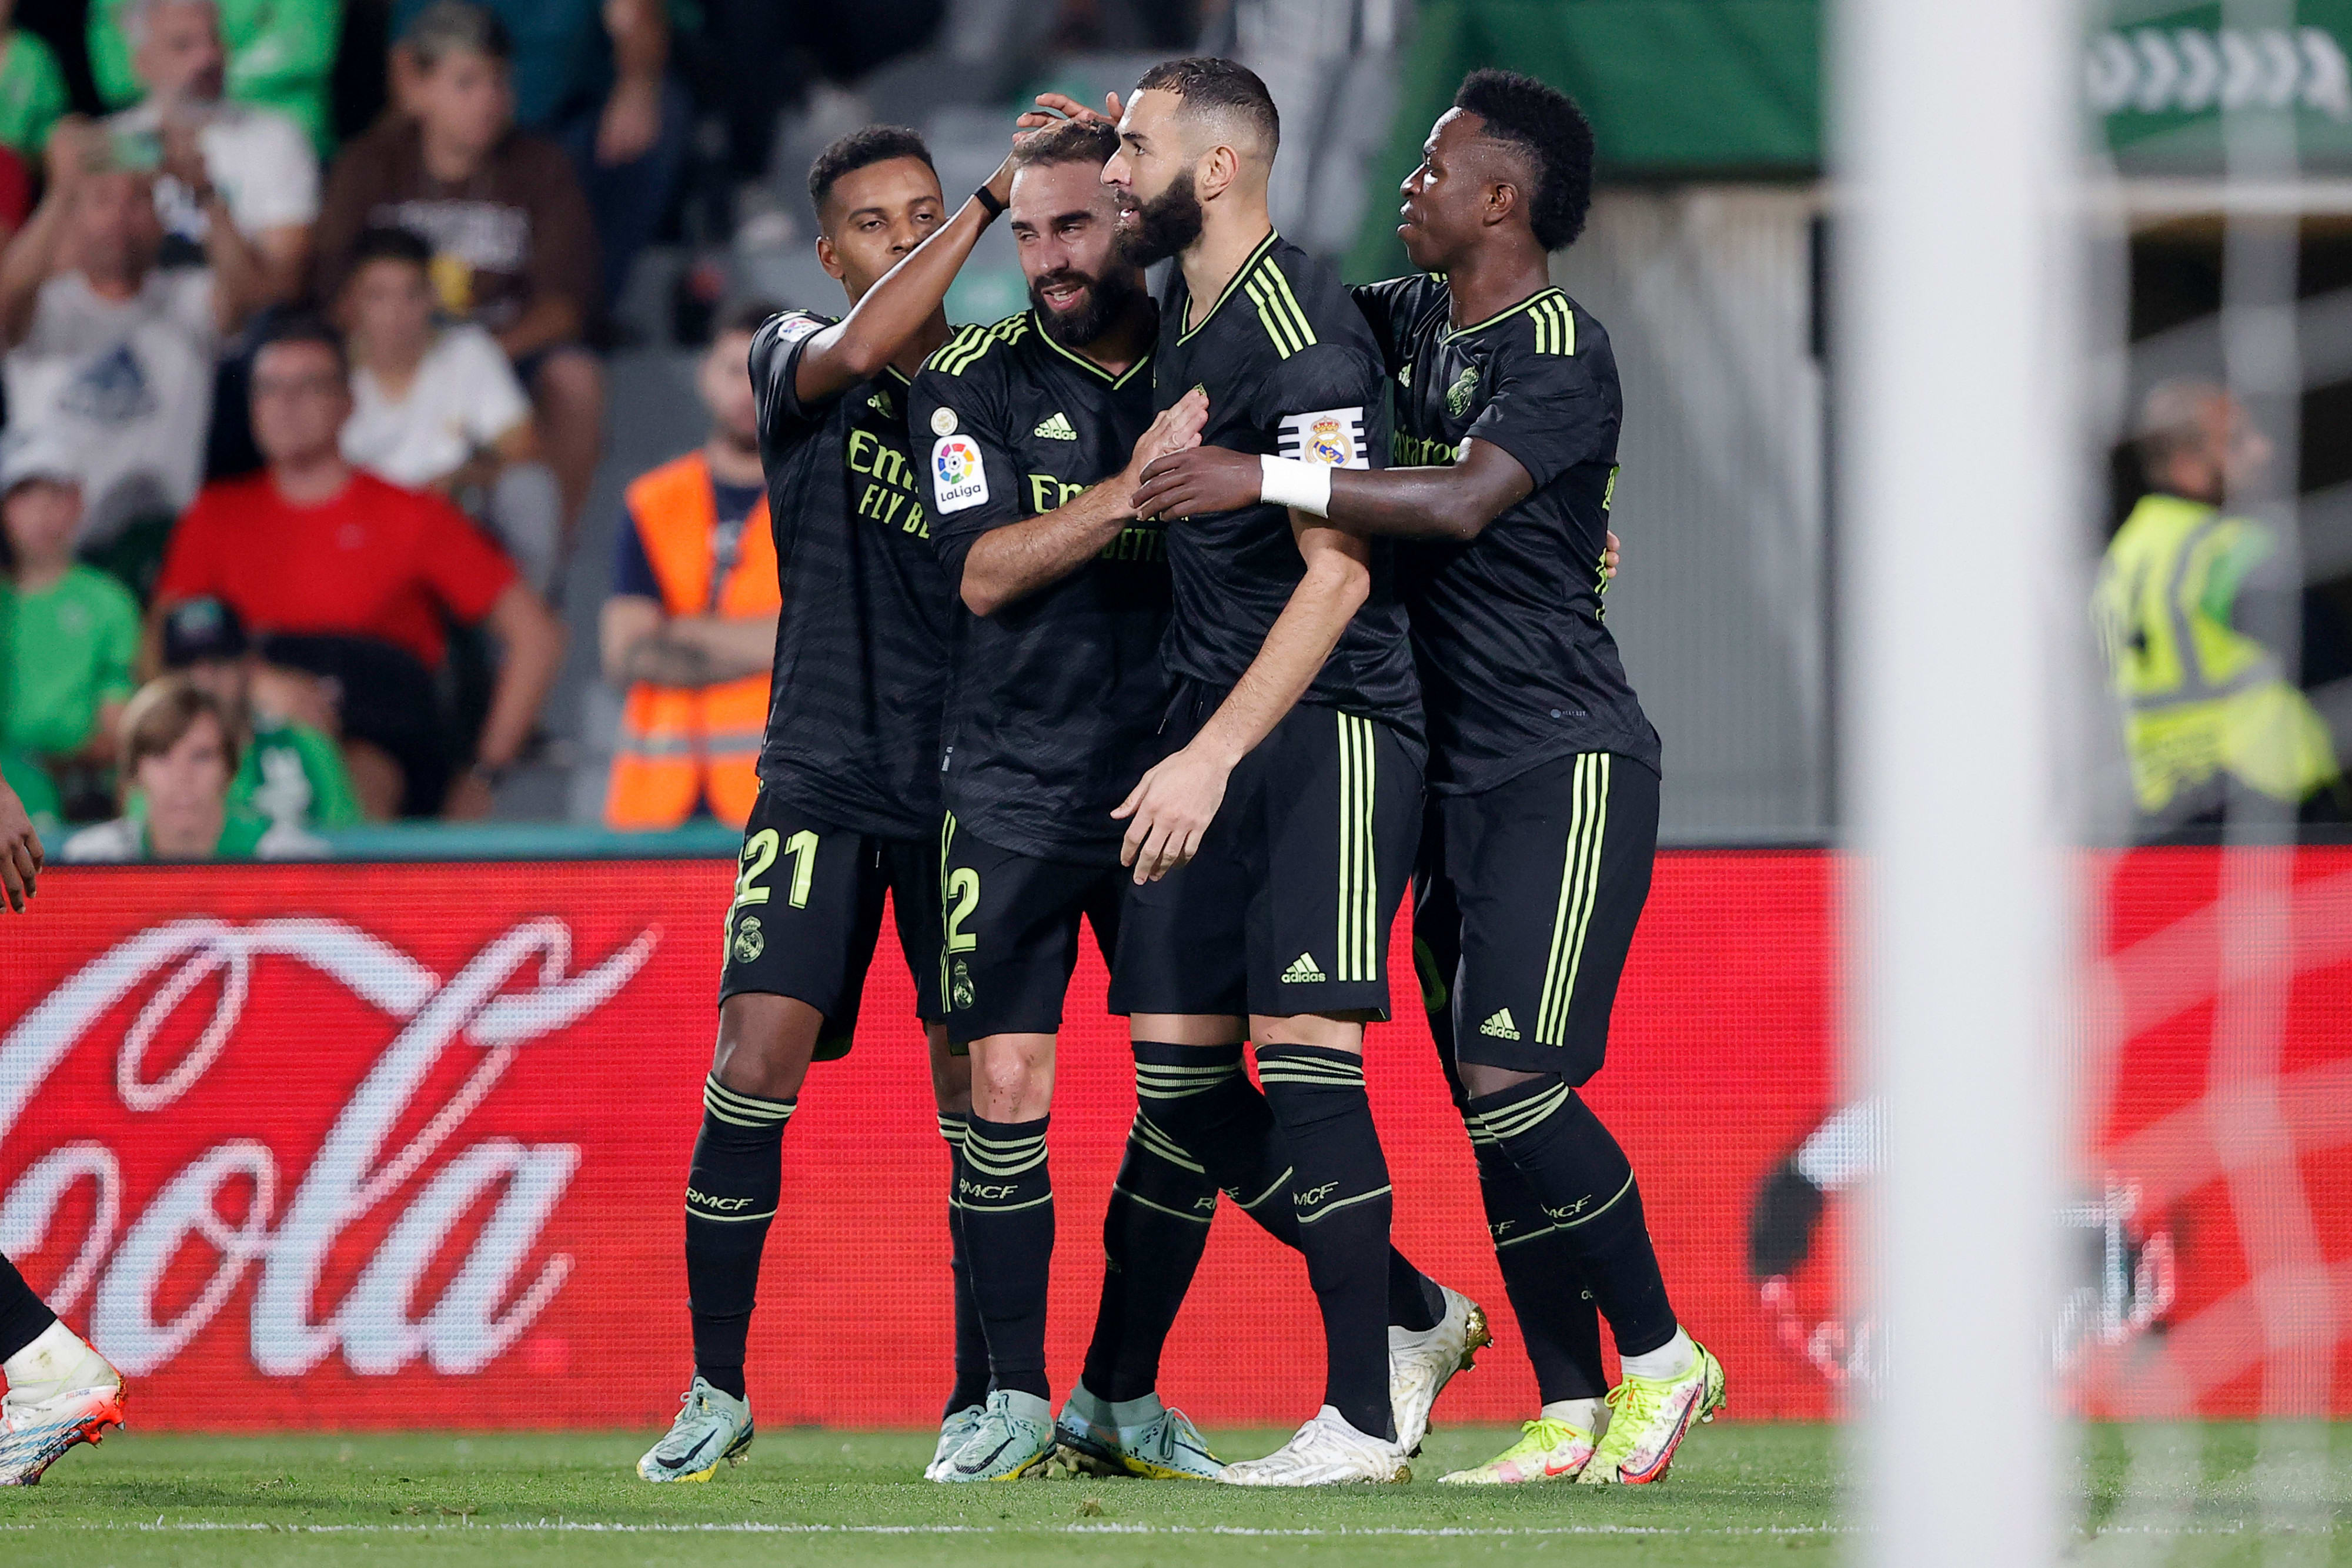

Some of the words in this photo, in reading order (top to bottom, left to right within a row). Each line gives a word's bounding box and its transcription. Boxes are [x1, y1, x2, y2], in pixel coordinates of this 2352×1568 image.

[1034, 426, 1077, 440] adidas
[858, 483, 905, 524] FLY
[940, 484, 981, 502] LaLiga
[737, 827, 820, 910] 21
[947, 867, 980, 954] 2
[1281, 971, 1327, 983] adidas
[1479, 1023, 1521, 1041] adidas
[684, 1186, 754, 1210] RMCF
